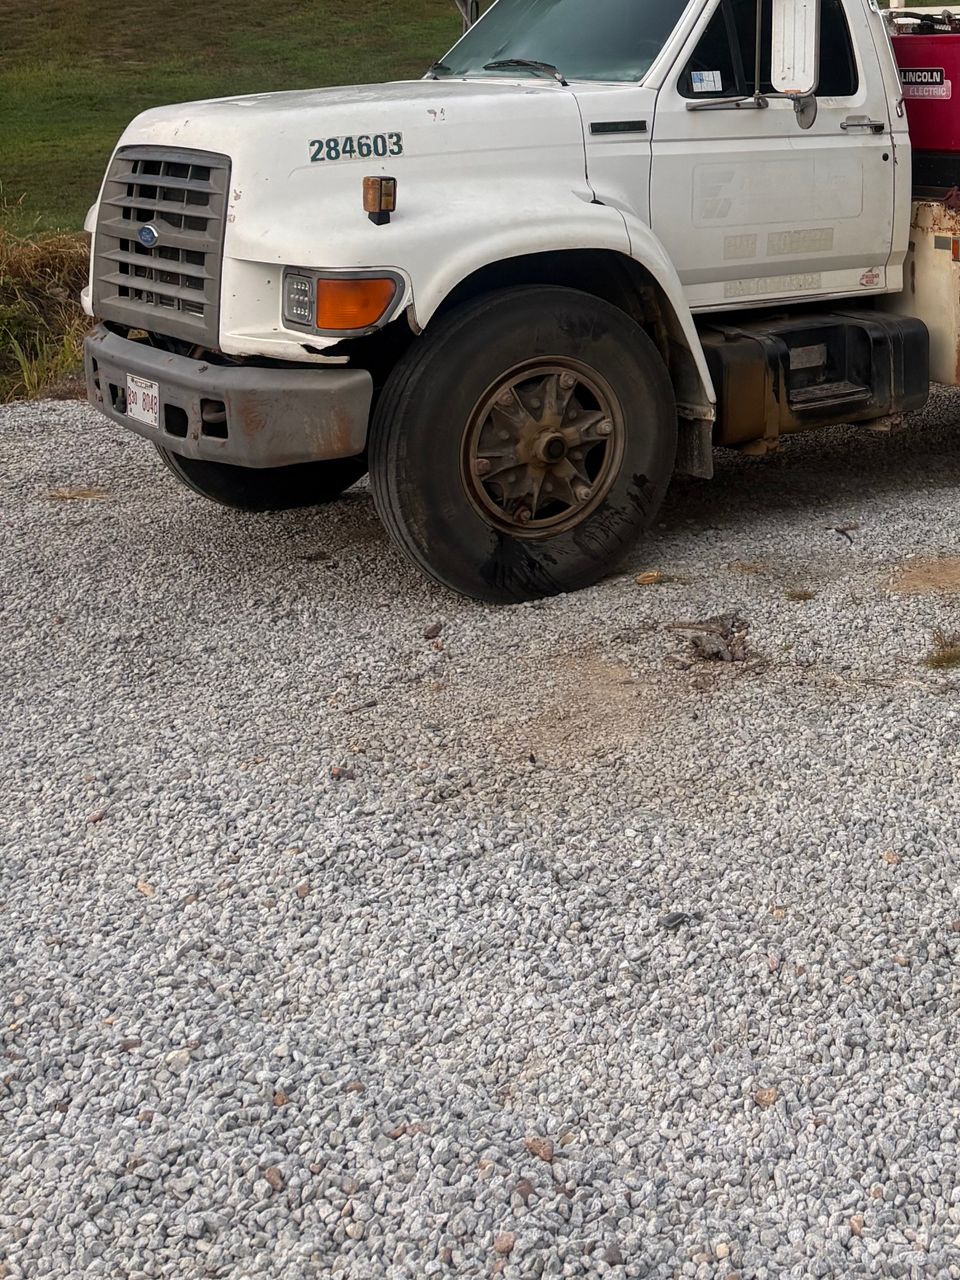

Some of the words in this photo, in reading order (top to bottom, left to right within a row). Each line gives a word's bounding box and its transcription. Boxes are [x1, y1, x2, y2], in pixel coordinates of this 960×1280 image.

[901, 71, 941, 82] LINCOLN
[910, 87, 947, 96] ELECTRIC
[309, 132, 403, 162] 284603
